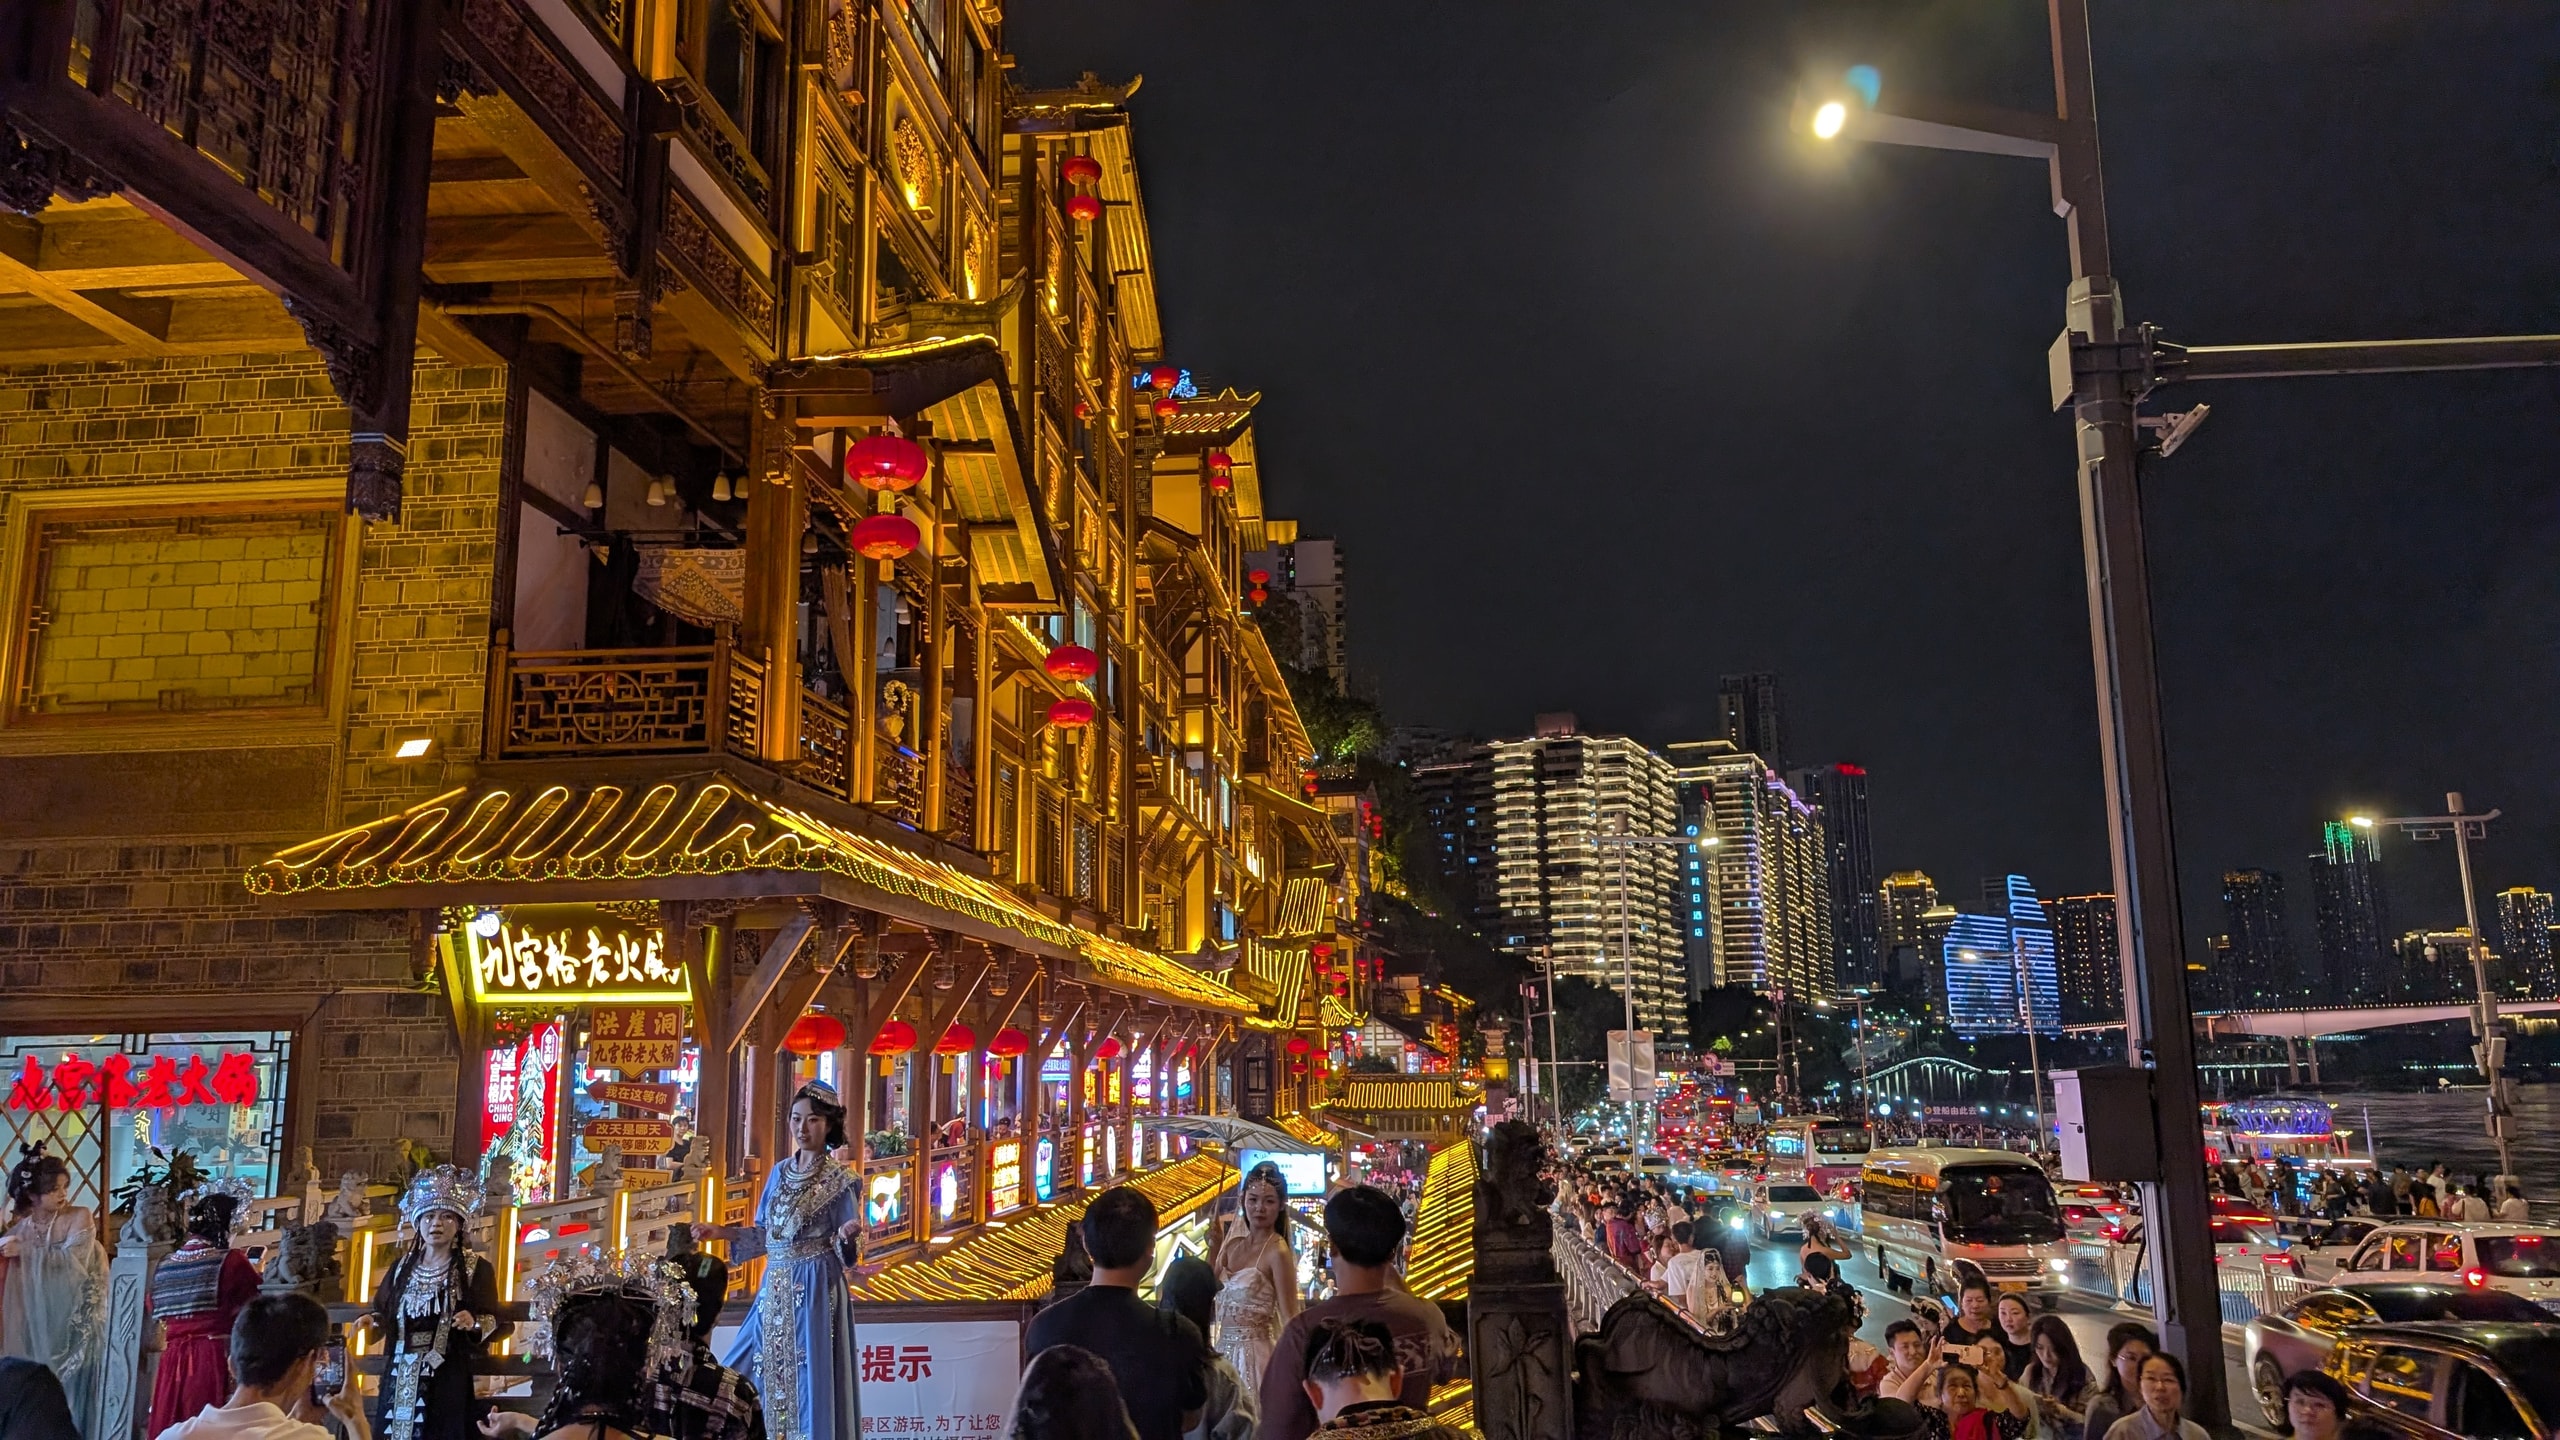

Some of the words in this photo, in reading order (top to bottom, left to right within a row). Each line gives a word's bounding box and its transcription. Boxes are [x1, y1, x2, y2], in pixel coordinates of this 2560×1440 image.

[481, 923, 681, 990] 九宫格老火锅
[596, 1009, 678, 1038] 洪崖洞
[594, 1041, 675, 1064] 九宫格老火锅
[9, 1053, 258, 1111] 九宫格老火锅
[605, 1084, 668, 1105] 我在这等你
[488, 1103, 514, 1114] CHING
[492, 1113, 513, 1123] QING
[1932, 1106, 1977, 1115] 登船由此去
[595, 1123, 661, 1136] 改天是哪天
